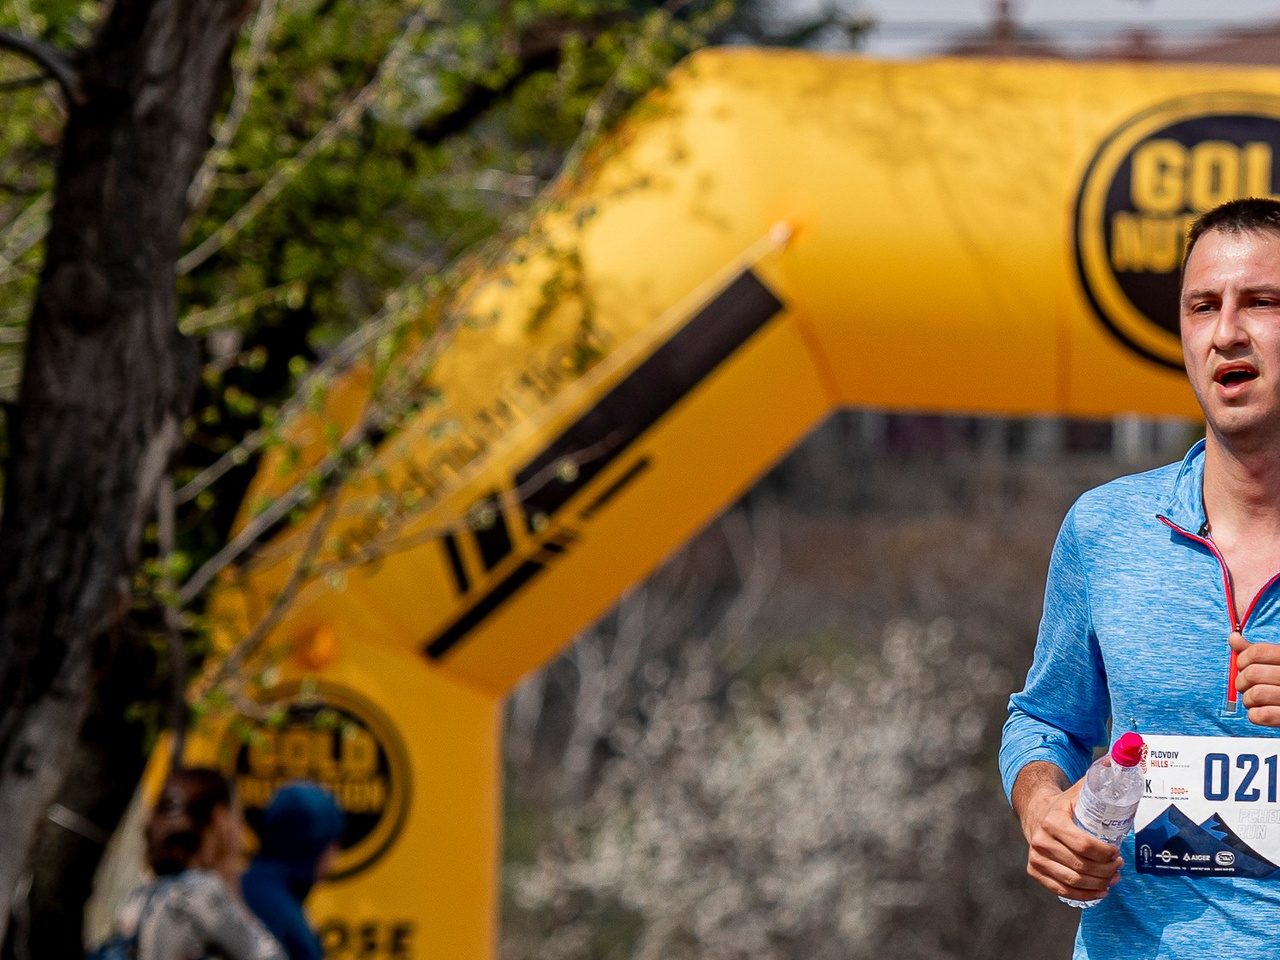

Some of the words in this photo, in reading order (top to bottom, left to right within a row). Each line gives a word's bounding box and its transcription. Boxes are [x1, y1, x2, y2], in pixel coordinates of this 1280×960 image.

[1150, 750, 1179, 759] PLOVDIV
[1150, 760, 1168, 768] HILLS
[1236, 825, 1267, 840] RUN
